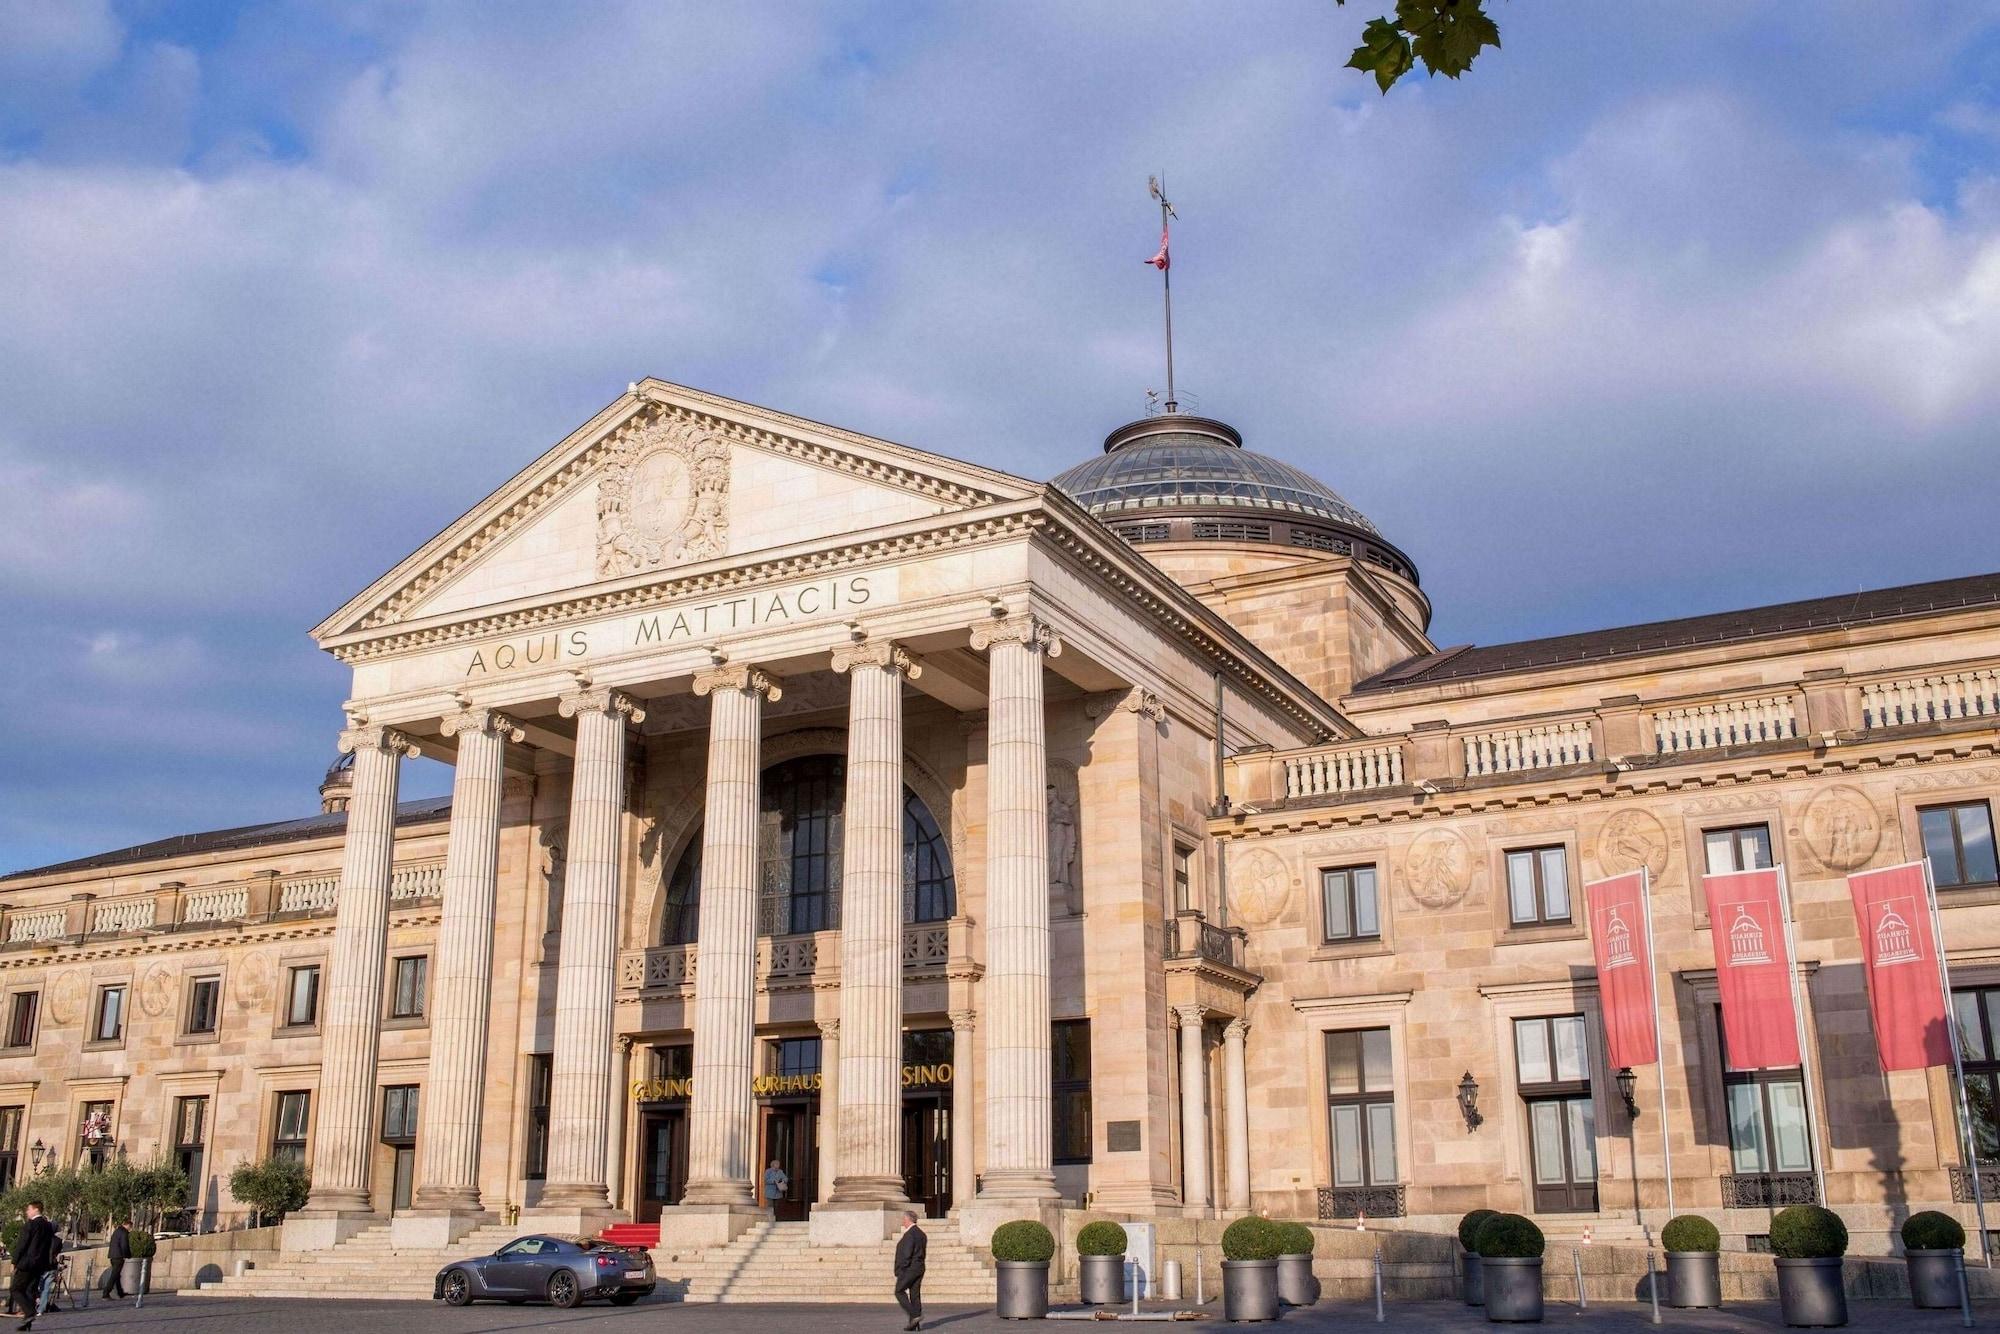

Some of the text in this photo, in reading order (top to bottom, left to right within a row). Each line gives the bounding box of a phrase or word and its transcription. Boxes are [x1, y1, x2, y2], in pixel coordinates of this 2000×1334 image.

[466, 577, 870, 677] AQUIS MATTIACIS
[902, 1063, 953, 1085] SINO
